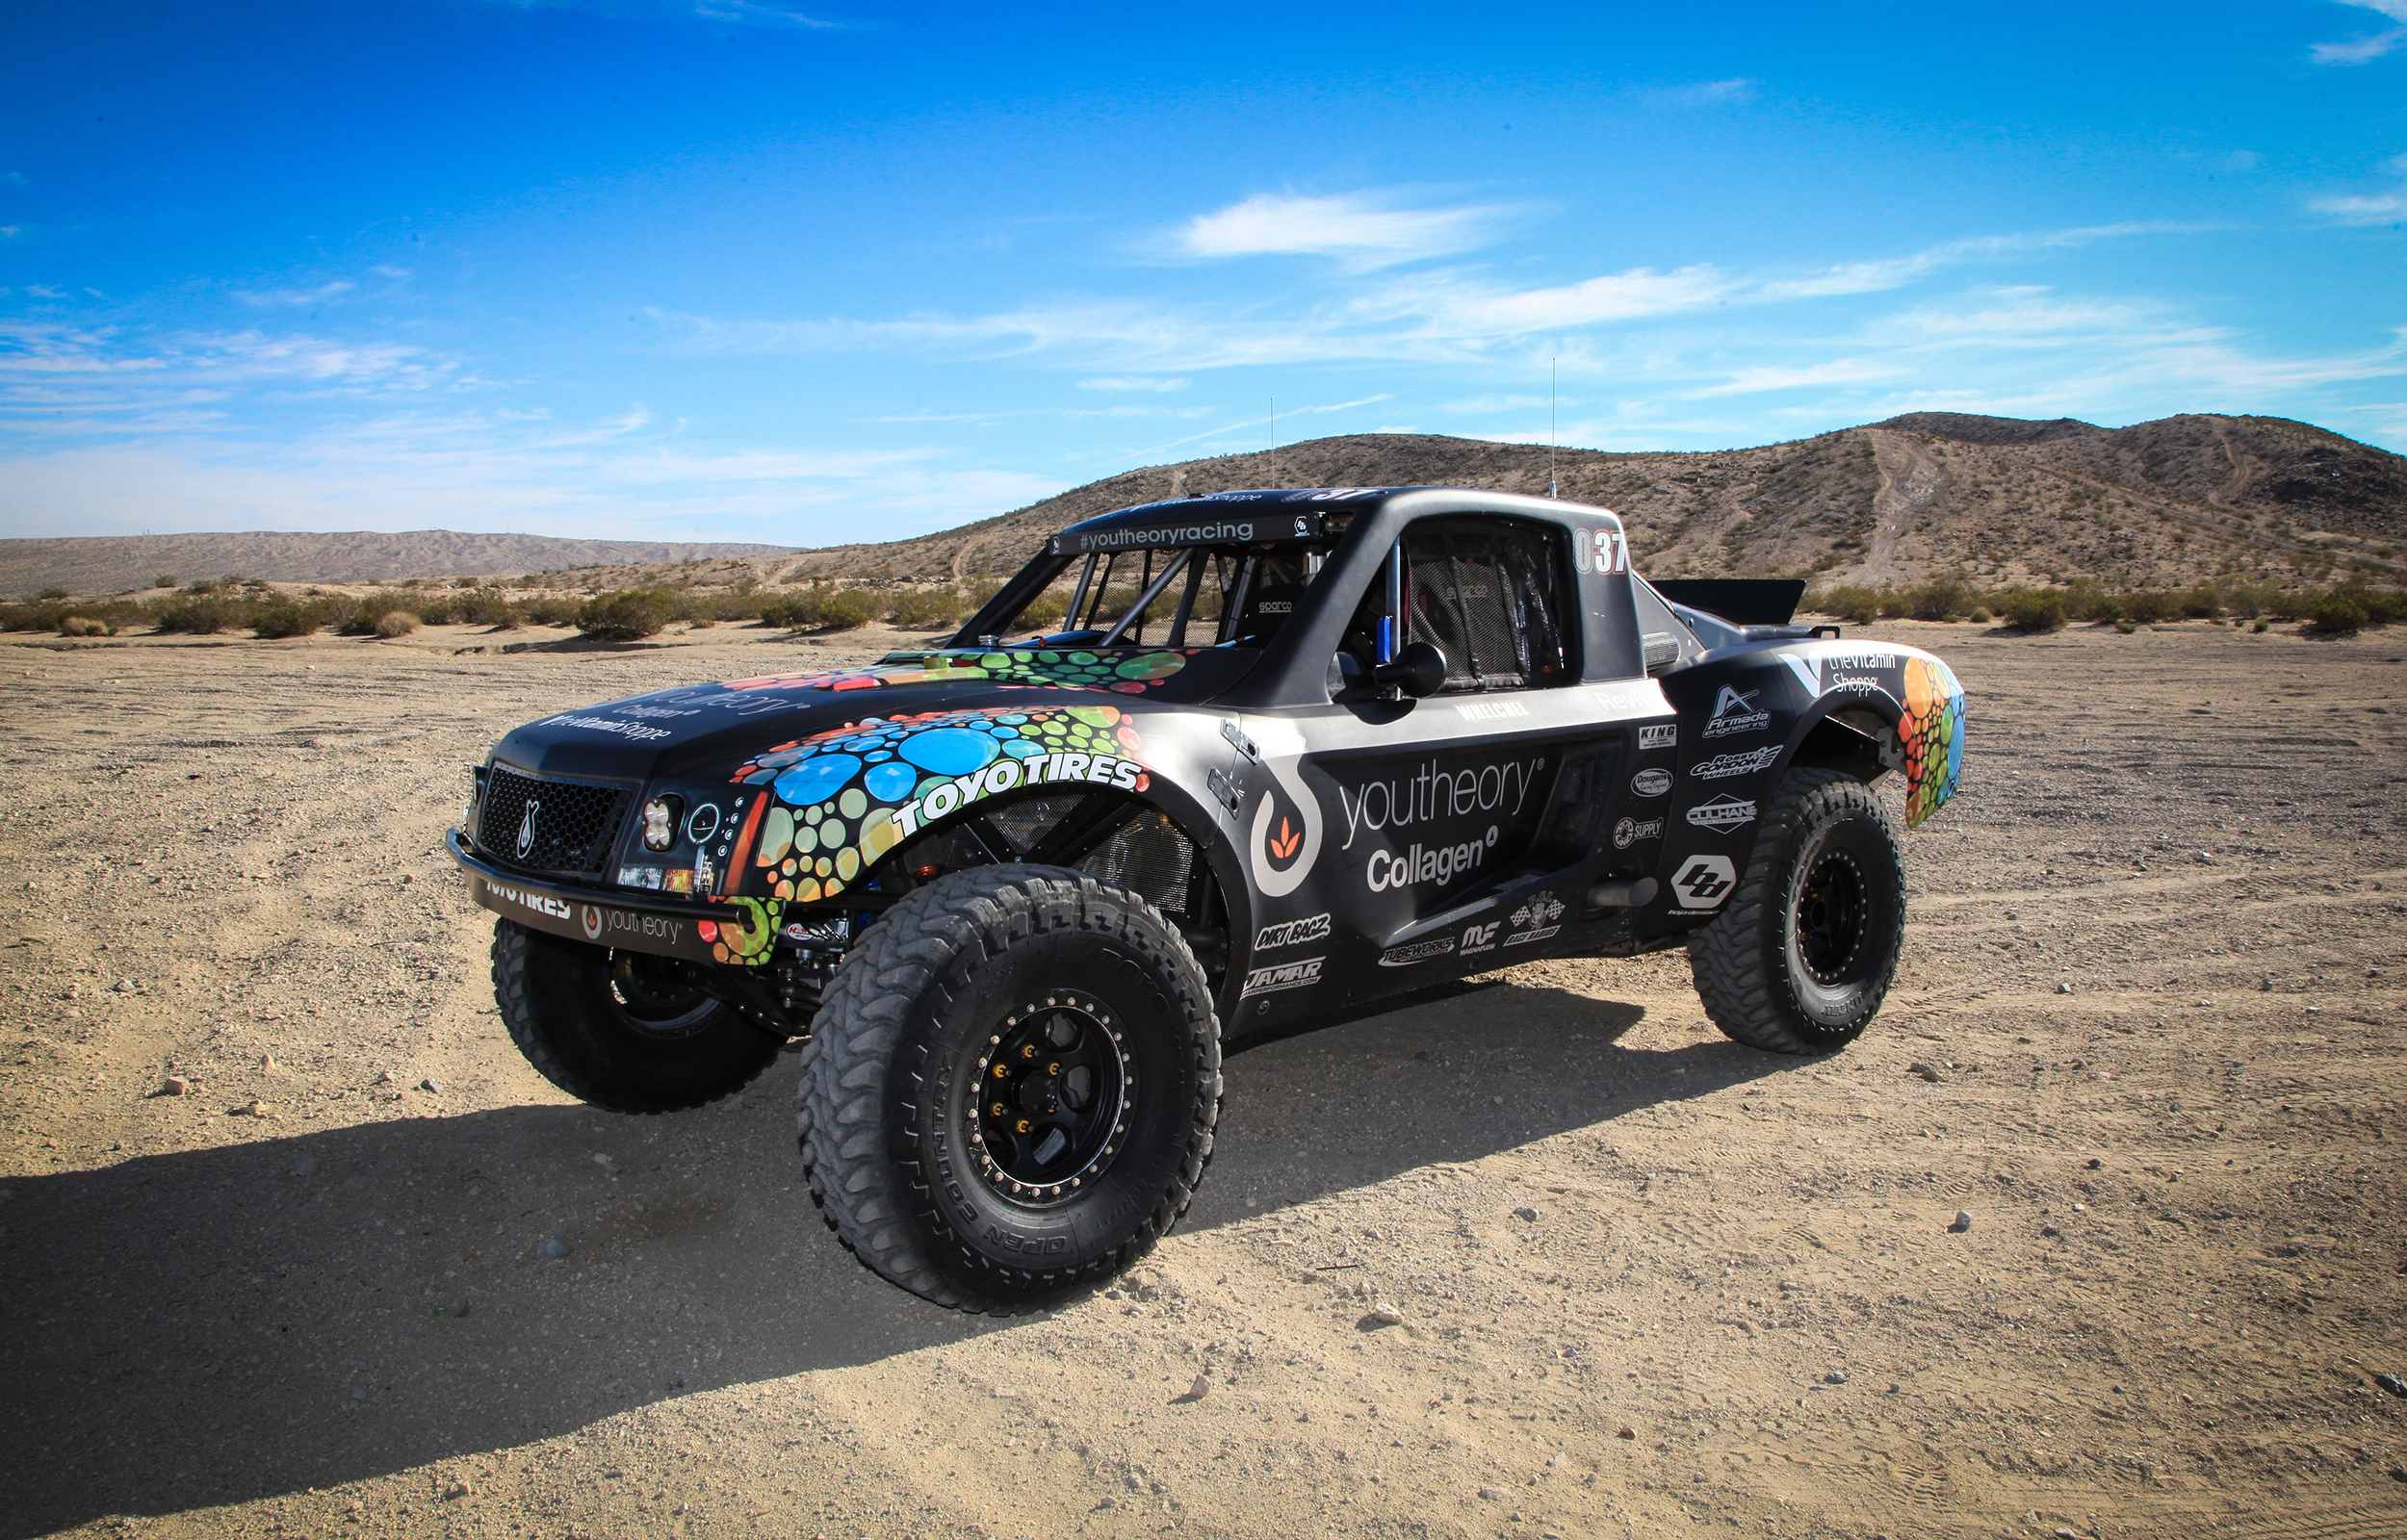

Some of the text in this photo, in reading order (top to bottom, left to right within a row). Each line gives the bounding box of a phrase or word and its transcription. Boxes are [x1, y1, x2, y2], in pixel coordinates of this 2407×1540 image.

[1079, 521, 1255, 551] #youtheoryracing
[1573, 528, 1626, 575] 037
[1258, 601, 1292, 613] sparco
[1832, 672, 1877, 698] Shoppe
[1454, 700, 1532, 723] WHELCHEL
[1707, 710, 1770, 731] Armada
[1640, 725, 1675, 739] KING
[1704, 720, 1768, 736] engineering
[1691, 756, 1761, 776] GORDON
[1703, 767, 1749, 780] WHEELS
[1637, 773, 1667, 784] Dougans
[892, 753, 1142, 838] TOYO TIRES
[1339, 757, 1537, 851] youtheory
[1686, 805, 1758, 821] CULHANE
[1616, 819, 1634, 834] ROD
[1634, 820, 1663, 838] SUPPLY
[1616, 834, 1633, 846] END
[1366, 838, 1484, 893] Collagen
[1255, 914, 1330, 949] DIRT BAGZ
[1383, 937, 1456, 962] TUBEWORKS
[1459, 942, 1496, 957] MAGNAFLOW
[1100, 947, 1171, 1014] TOYO
[1243, 962, 1323, 992] JAMAR
[933, 1054, 980, 1224] COUNTRY
[986, 1223, 1067, 1255] OPEN
